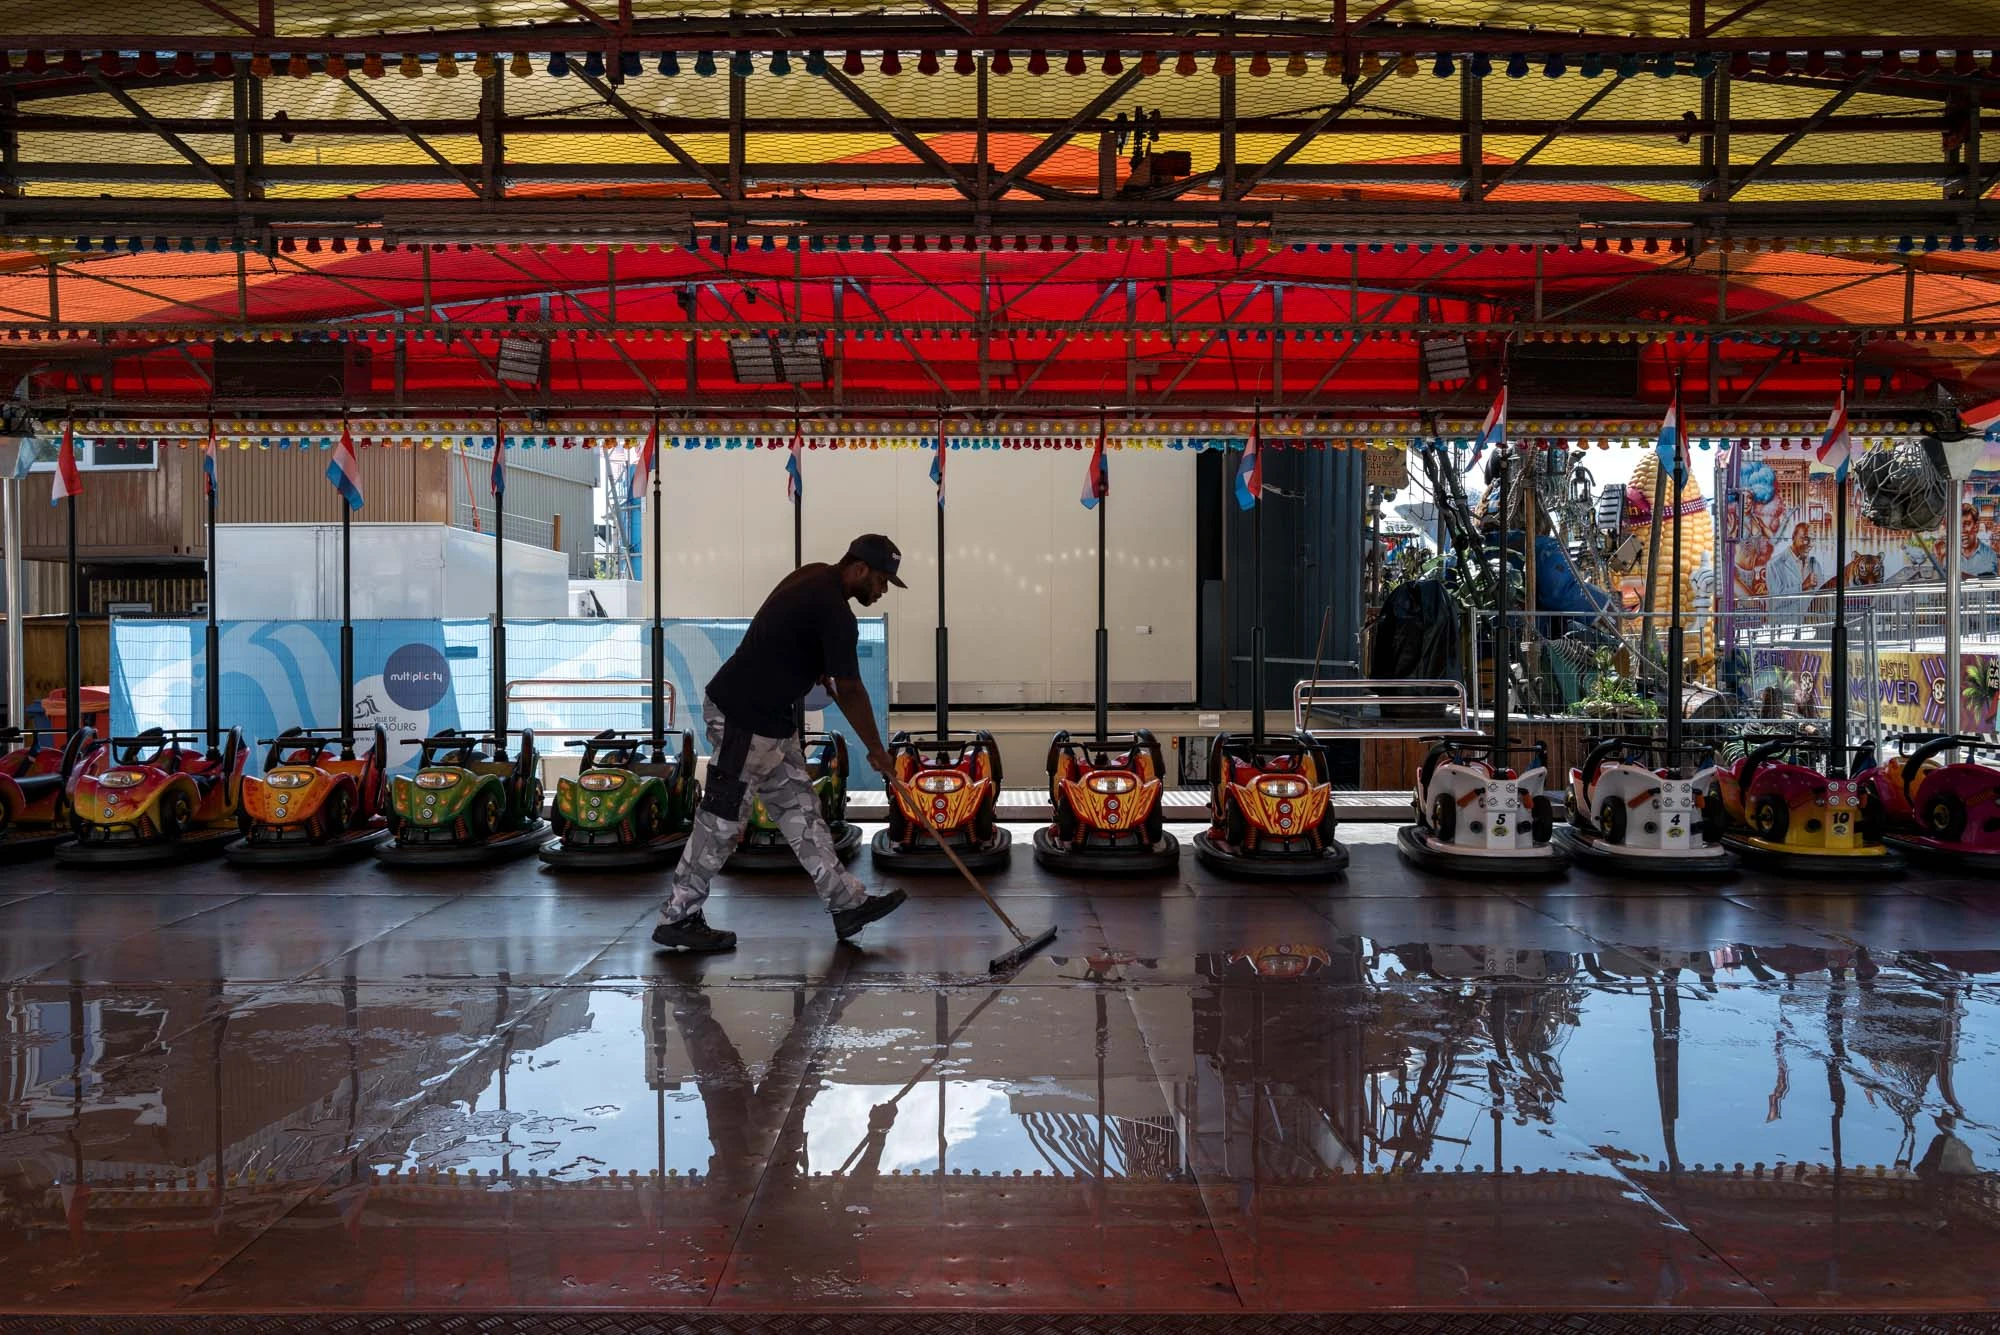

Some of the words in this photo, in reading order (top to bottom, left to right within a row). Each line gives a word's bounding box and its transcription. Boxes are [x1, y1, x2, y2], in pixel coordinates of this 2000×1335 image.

[390, 671, 443, 683] multiplicity
[1496, 814, 1506, 825] 5
[1671, 814, 1680, 825] 4
